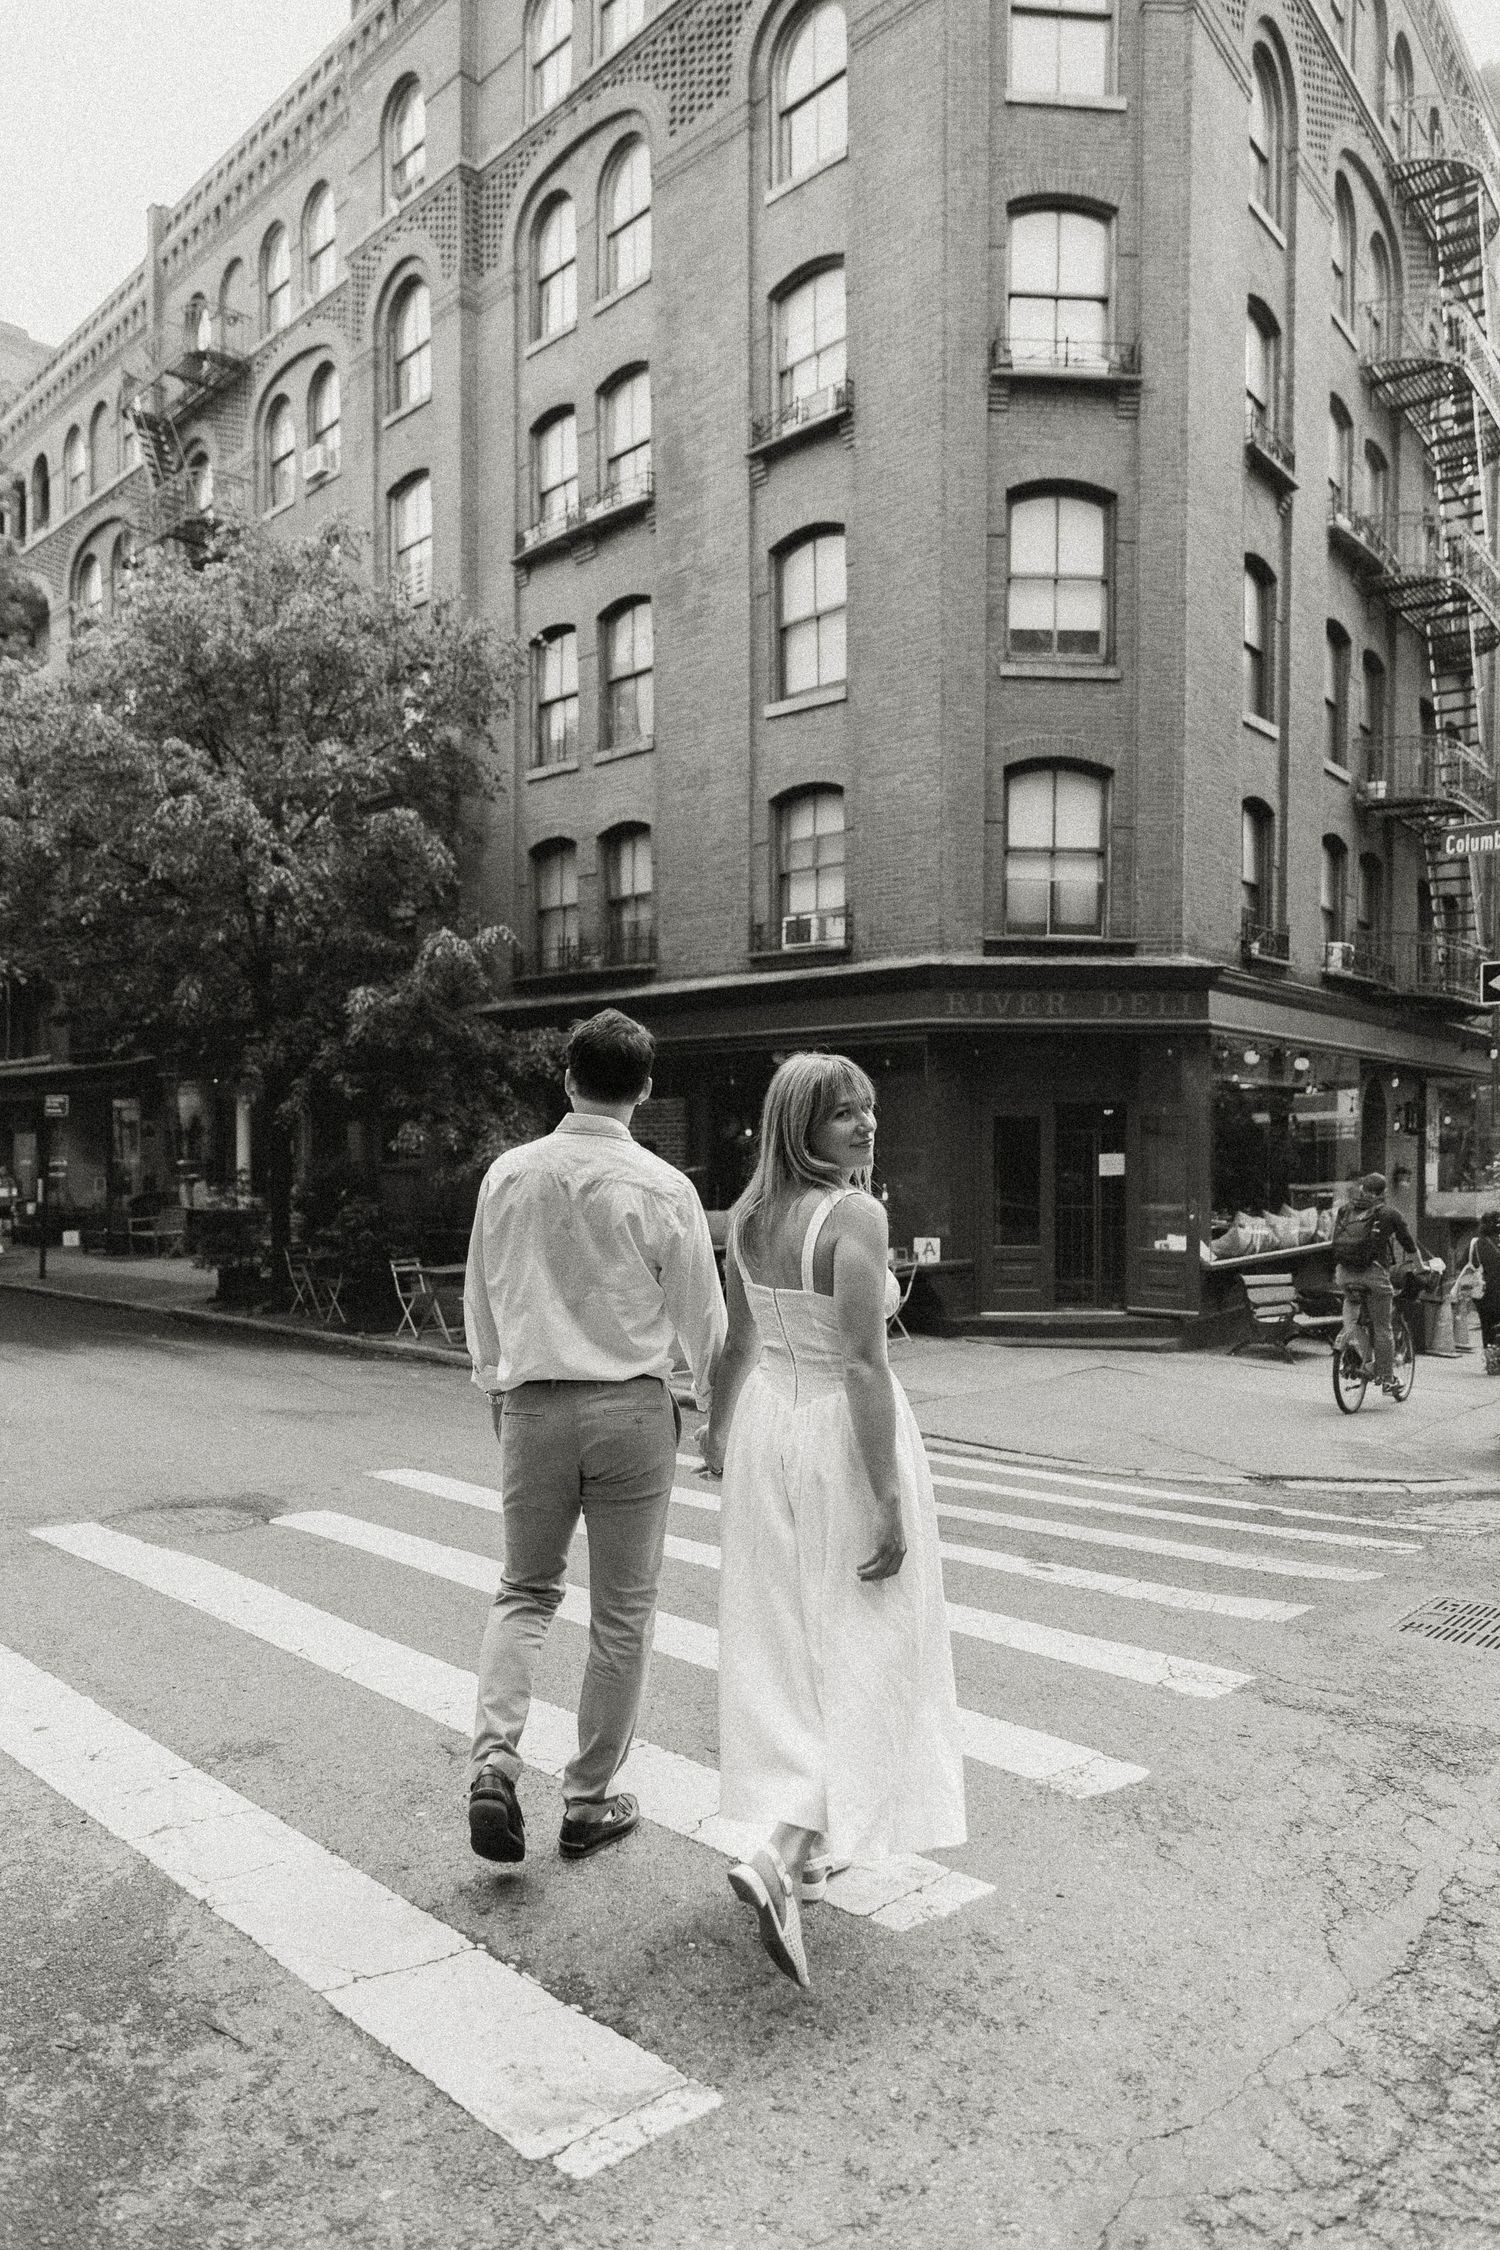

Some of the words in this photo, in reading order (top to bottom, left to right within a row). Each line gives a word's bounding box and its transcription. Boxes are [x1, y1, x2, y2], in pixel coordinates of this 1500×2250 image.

[945, 992, 1068, 1016] RIVER
[1100, 992, 1192, 1016] DELI
[922, 1241, 936, 1256] A
